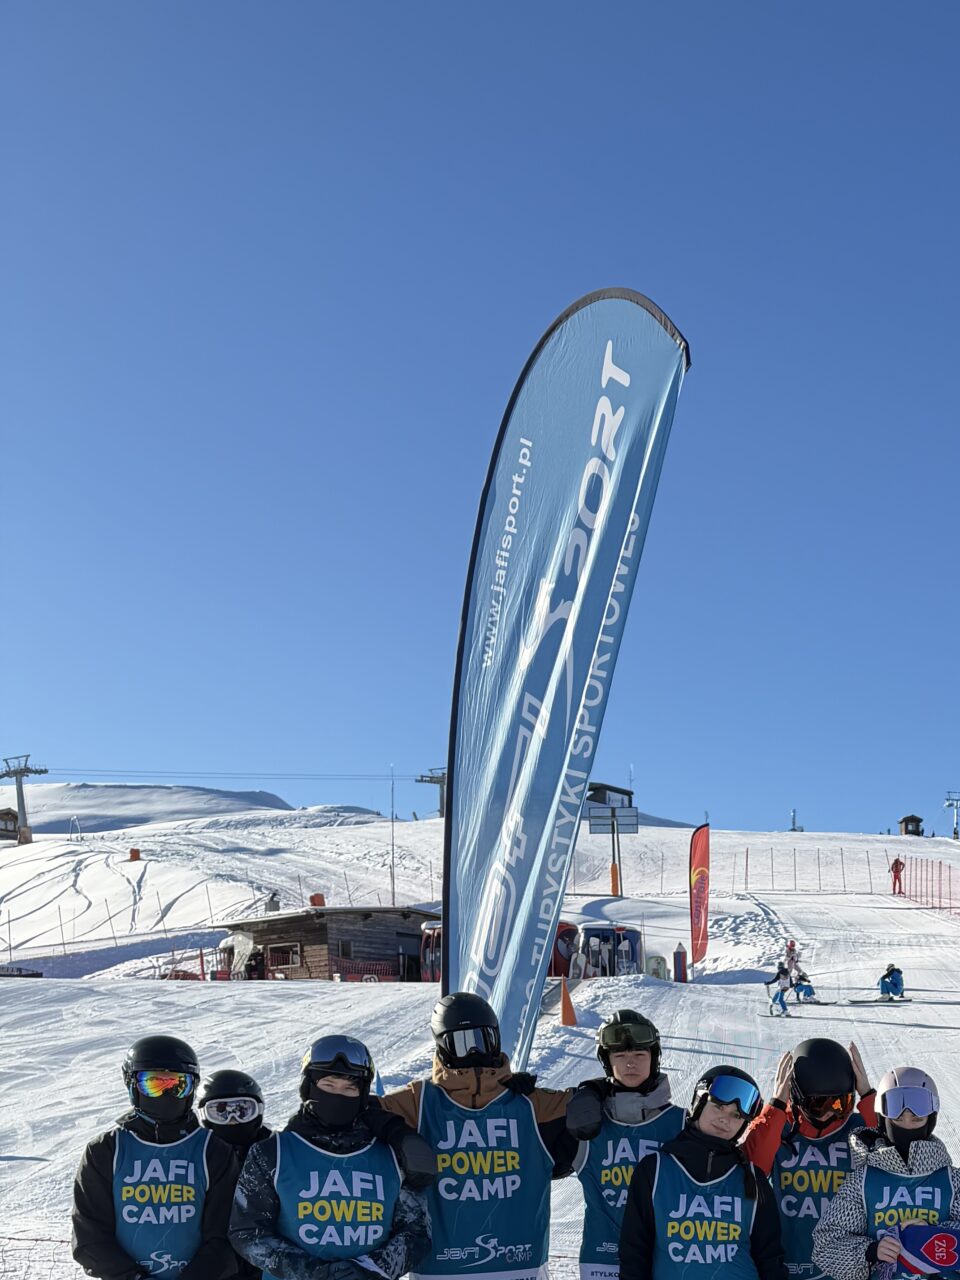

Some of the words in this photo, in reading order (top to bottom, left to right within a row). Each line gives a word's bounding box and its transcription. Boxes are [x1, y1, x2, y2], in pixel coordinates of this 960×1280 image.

[482, 437, 533, 669] www.jafisport.pl
[436, 1118, 520, 1150] JAFI
[436, 1150, 521, 1175] POWER
[601, 1137, 665, 1167] JAF
[123, 1159, 195, 1185] JAFI
[601, 1165, 634, 1186] POW
[780, 1169, 849, 1194] POWE
[121, 1184, 195, 1204] POWER
[298, 1169, 385, 1201] JAFI
[438, 1174, 521, 1201] CAMP
[669, 1193, 742, 1223] JAFI
[875, 1186, 942, 1210] JAFI
[122, 1204, 196, 1225] CAMP
[297, 1200, 384, 1222] POWER
[874, 1207, 940, 1227] POWER
[298, 1223, 384, 1246] CAMP
[667, 1220, 742, 1241] POWER
[506, 1251, 533, 1263] CAMP
[668, 1241, 739, 1264] CAMP
[934, 1239, 947, 1261] ZSE
